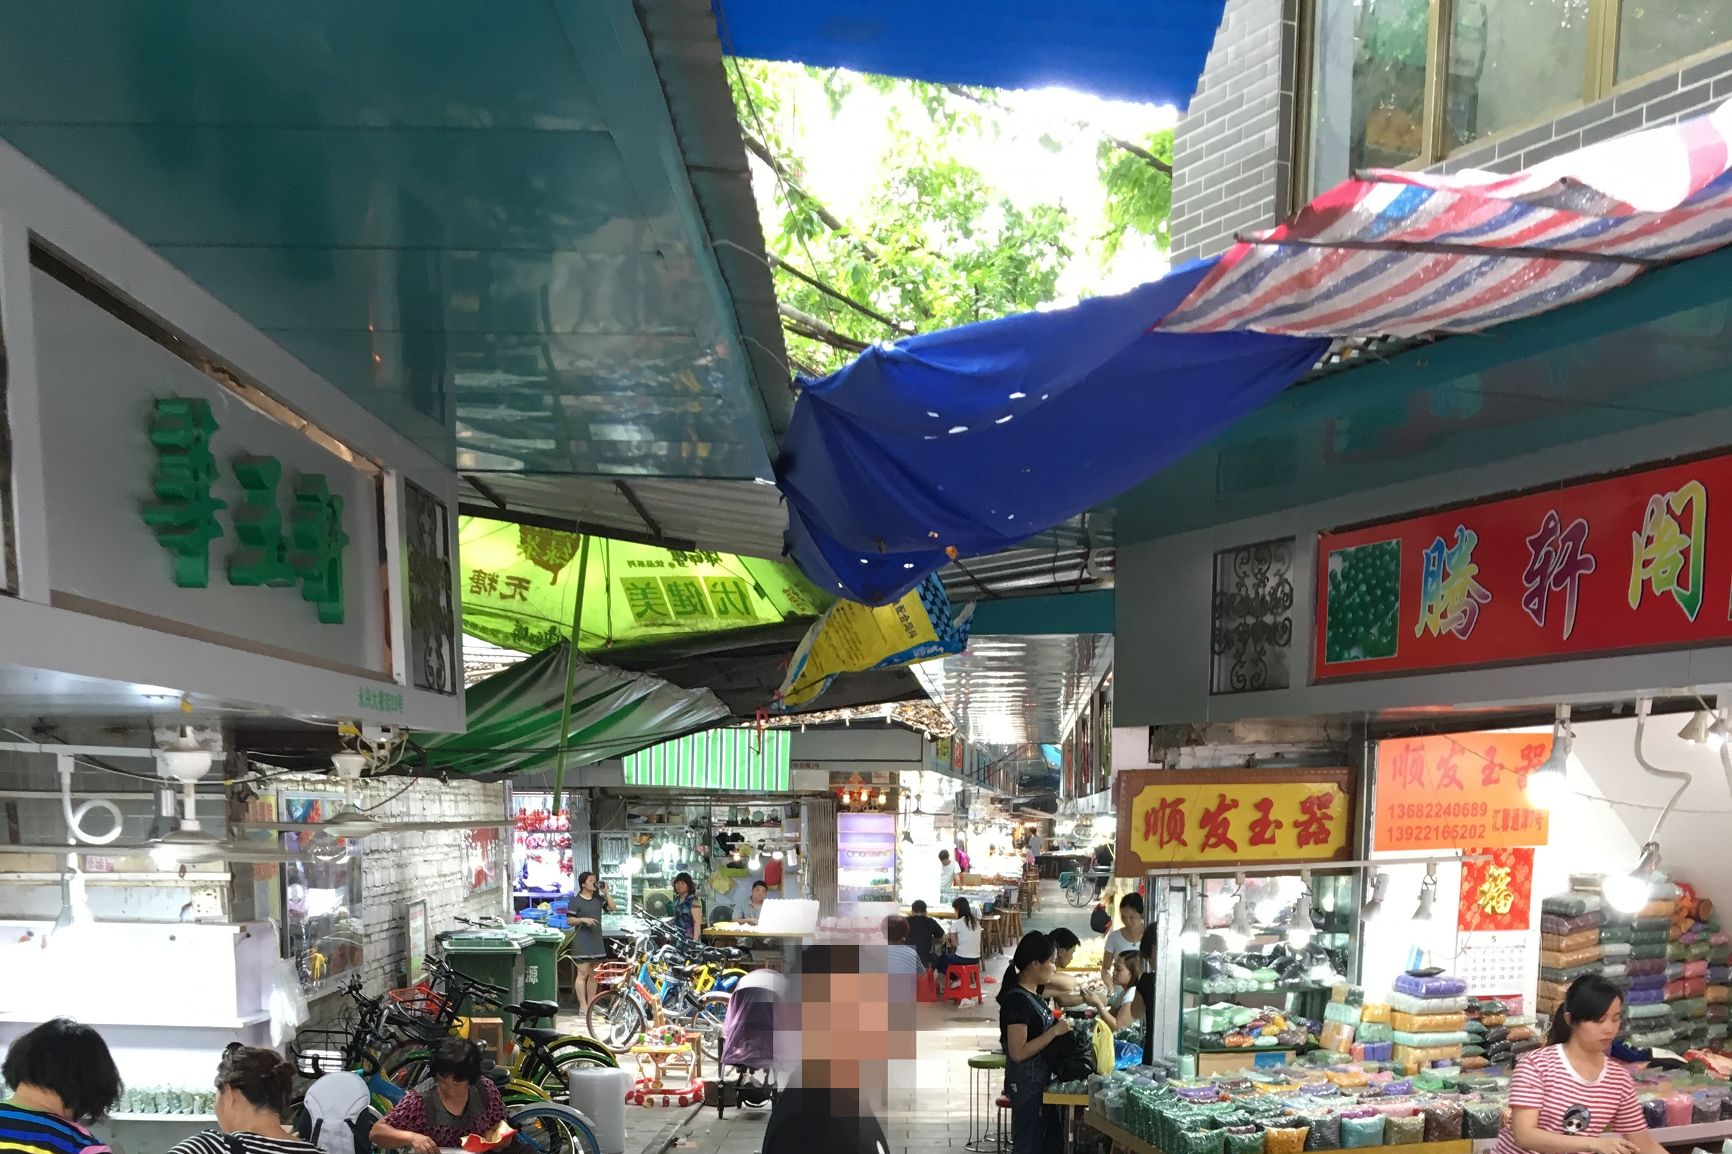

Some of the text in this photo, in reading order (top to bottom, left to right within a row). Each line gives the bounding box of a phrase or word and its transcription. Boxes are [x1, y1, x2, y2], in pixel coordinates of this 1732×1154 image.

[1414, 479, 1708, 640] 腾轩阁
[1392, 743, 1546, 791] 顺发玉器
[1144, 791, 1334, 853] 顺发玉器
[1388, 802, 1488, 819] 13682240689
[1478, 864, 1515, 915] 福
